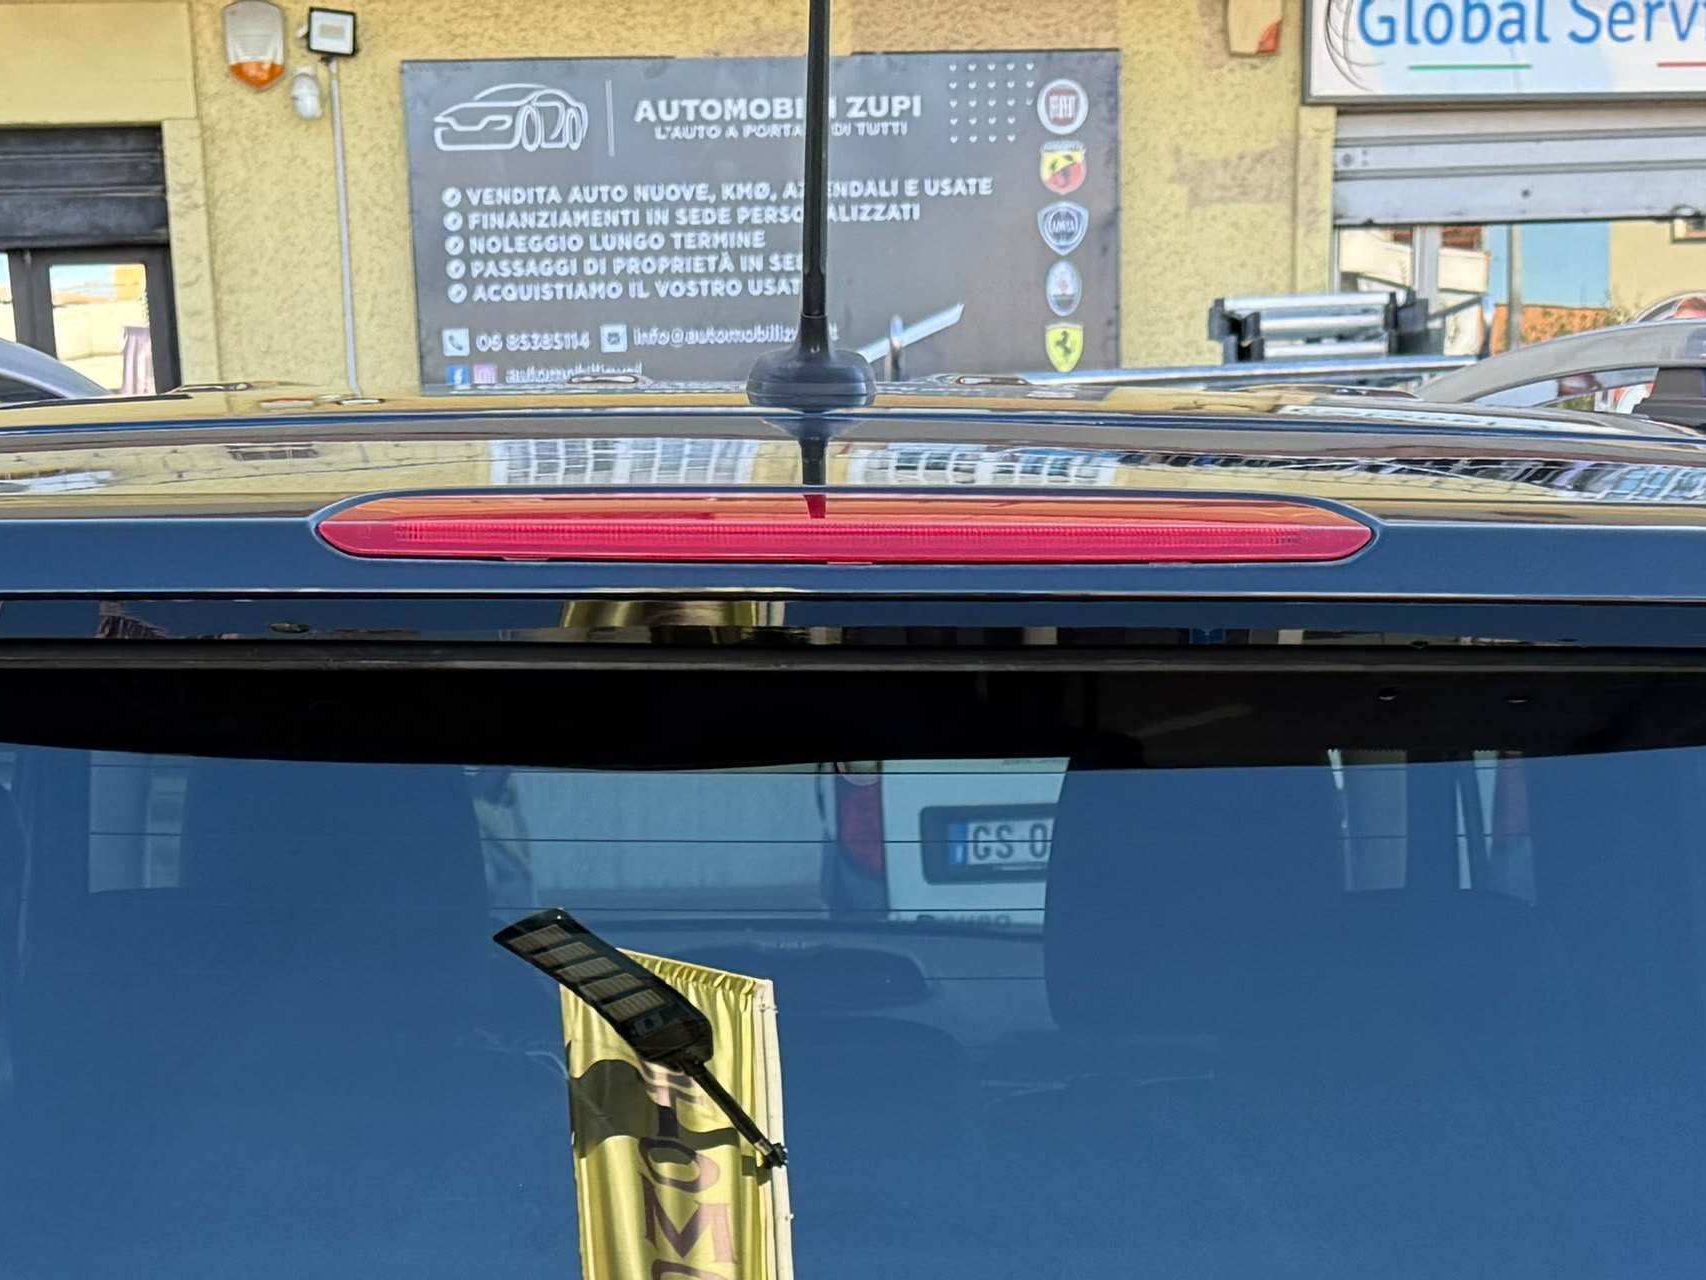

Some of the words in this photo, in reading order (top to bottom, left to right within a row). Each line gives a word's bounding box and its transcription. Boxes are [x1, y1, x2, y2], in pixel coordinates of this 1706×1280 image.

[1356, 0, 1550, 46] Global
[634, 97, 837, 122] AUTOMOBII
[846, 95, 922, 118] ZUPI
[725, 124, 739, 138] A
[832, 122, 851, 136] DI
[854, 120, 908, 136] TUTTI
[466, 186, 562, 206] VENDITA
[570, 184, 628, 203] AUTO
[633, 182, 716, 204] NUOVE,
[905, 179, 919, 197] E
[924, 177, 993, 197] USATE
[468, 207, 640, 230] FINANZIAMENTI
[646, 207, 669, 227] IN
[675, 205, 732, 226] SEDE
[737, 202, 921, 224] PERSOALIZZATI
[469, 233, 583, 255] NOLEGGIO
[589, 231, 665, 252] LUNGO
[670, 229, 766, 249] TERMINE
[471, 256, 577, 279] PASSAGGI
[583, 256, 606, 276] DI
[612, 251, 734, 277] PROPRIETÀ
[740, 253, 764, 273] IN
[472, 280, 623, 303] ACQUISTIAMO
[629, 280, 650, 300] IL
[654, 278, 742, 299] VOSTRO
[973, 824, 1014, 861] GS
